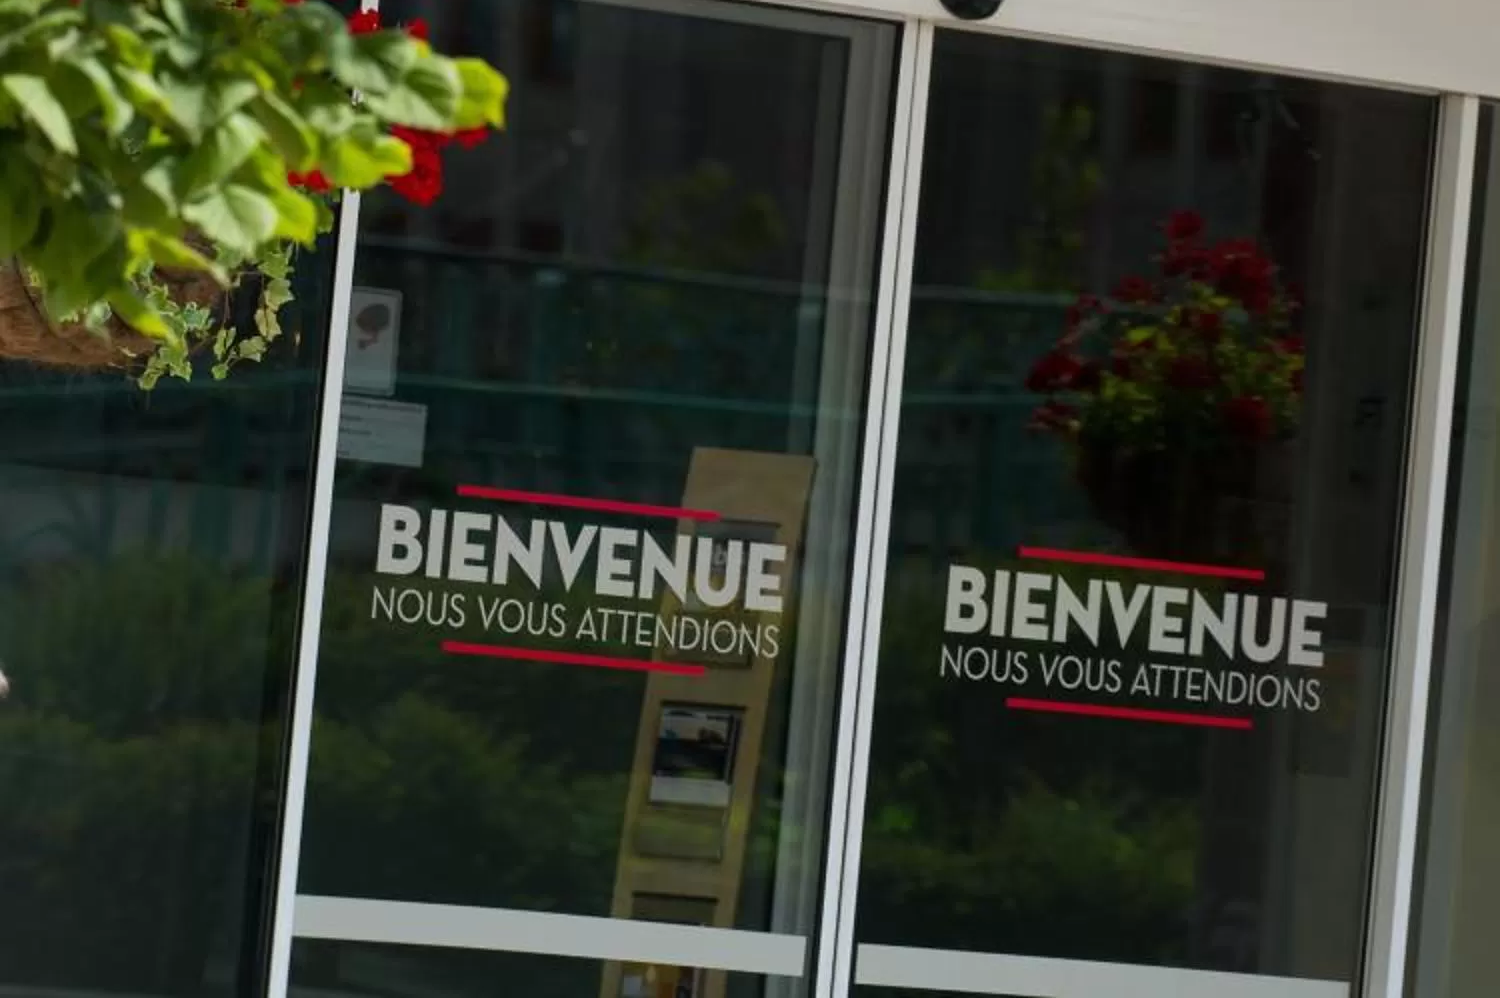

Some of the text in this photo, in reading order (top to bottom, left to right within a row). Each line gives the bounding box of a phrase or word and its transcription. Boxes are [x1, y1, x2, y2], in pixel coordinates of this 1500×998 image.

[376, 503, 787, 612] BIENVENUE
[370, 586, 780, 659] NOUS VOUS ATTENDIONS
[944, 564, 1328, 668] BIENVENUE
[940, 644, 1321, 711] NOUS VOUS ATTENDIONS
